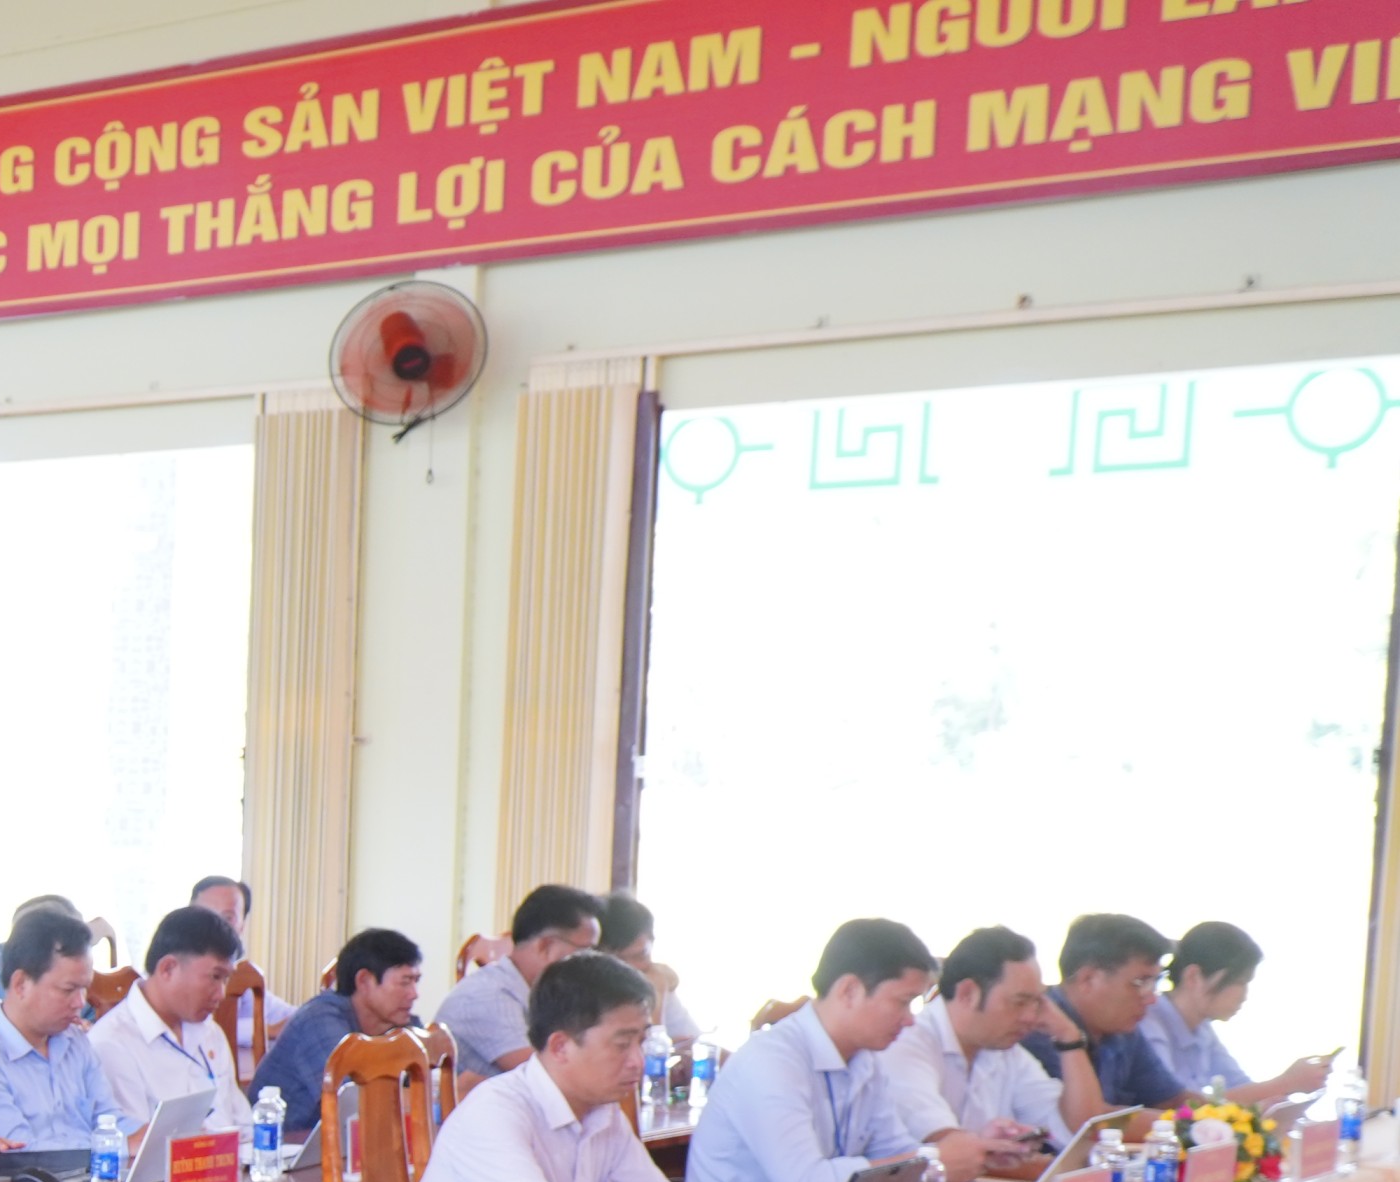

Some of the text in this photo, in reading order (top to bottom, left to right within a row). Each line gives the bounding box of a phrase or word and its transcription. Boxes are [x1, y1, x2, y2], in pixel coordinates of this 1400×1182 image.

[25, 211, 140, 275] MỌI
[160, 175, 374, 251] THẮNG
[398, 161, 505, 228] LỢI
[530, 126, 684, 207] CỦA
[711, 100, 937, 184] CÁCH
[966, 58, 1252, 152] MẠNG
[55, 121, 220, 192] CỘNG
[242, 83, 379, 161] SẢN
[402, 56, 553, 135] VIỆT
[576, 27, 760, 108] NAM
[790, 42, 821, 60] -
